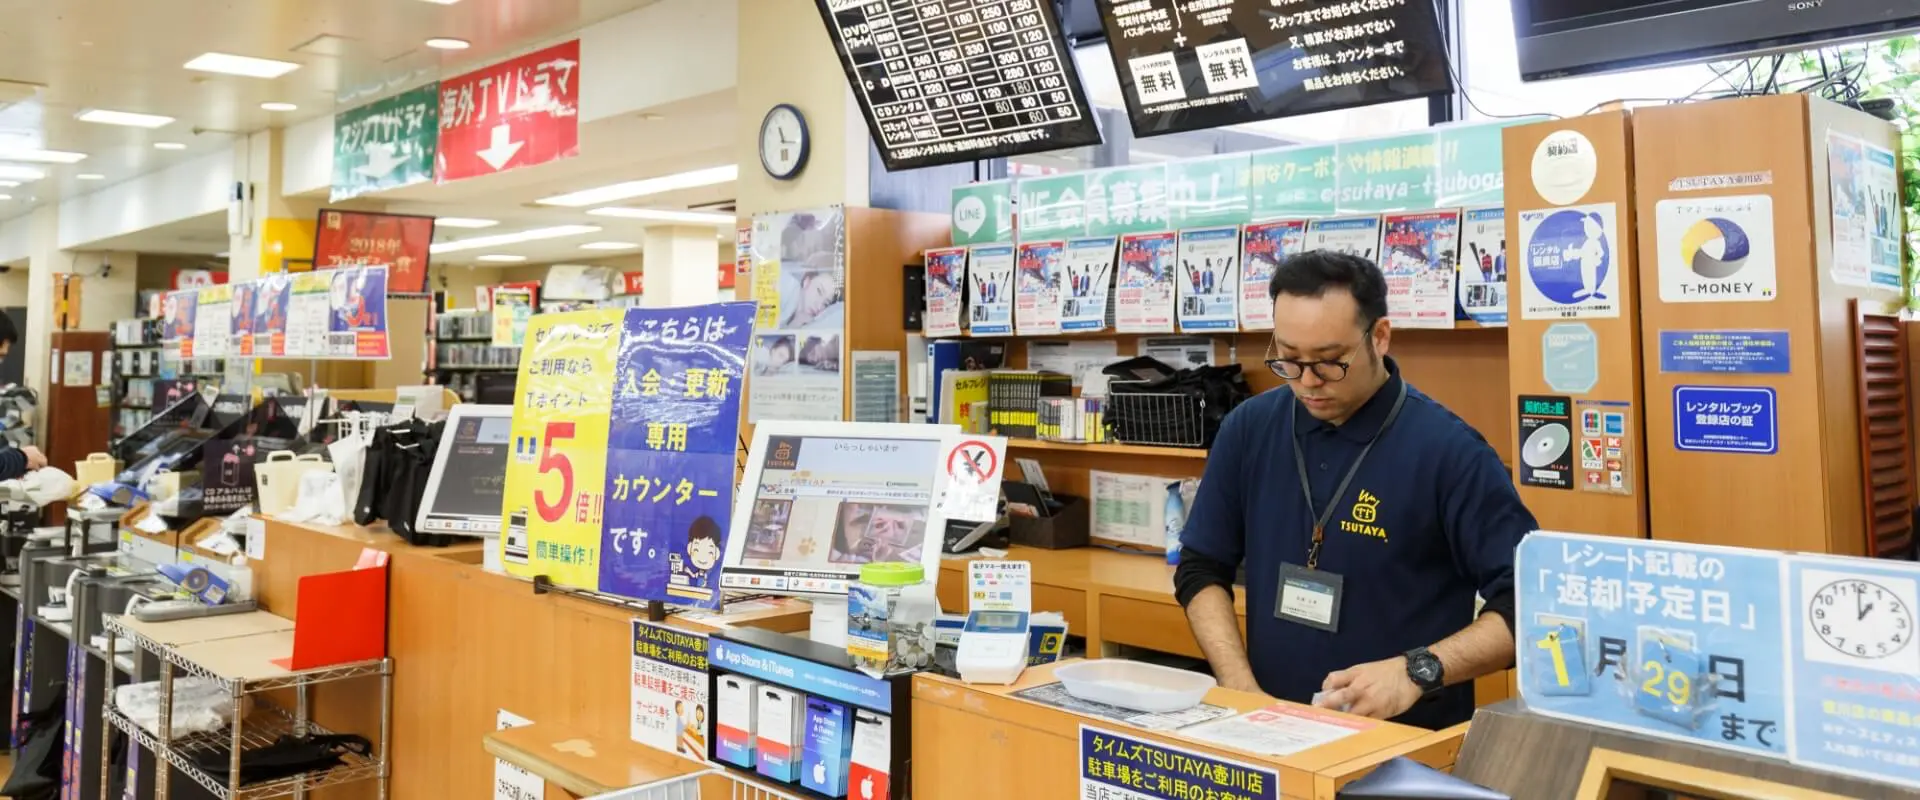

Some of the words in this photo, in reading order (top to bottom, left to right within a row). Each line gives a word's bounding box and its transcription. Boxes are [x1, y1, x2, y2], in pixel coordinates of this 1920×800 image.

[921, 5, 940, 17] 300
[981, 6, 1001, 19] 250
[1788, 0, 1823, 11] SONY
[843, 23, 869, 37] DVD
[987, 21, 1007, 34] 100
[1016, 14, 1037, 28] 100
[1022, 30, 1043, 43] 120
[998, 52, 1019, 64] 300
[1028, 45, 1048, 58] 120
[924, 83, 942, 95] 220
[1034, 61, 1054, 73] 120
[441, 58, 577, 129] 海外TVドラマ
[956, 92, 975, 104] 100
[983, 87, 1002, 99] 120
[1011, 80, 1031, 94] 180
[1040, 76, 1060, 88] 100
[959, 208, 981, 222] LINE
[1680, 282, 1753, 295] T-MONEY
[643, 315, 727, 342] こちらは
[529, 357, 593, 376] ご利用なら
[622, 368, 730, 399] 入会・更新
[526, 391, 587, 409] Tポイント
[1686, 401, 1762, 414] レンタルブック
[1696, 414, 1753, 427] 登録店の証
[647, 423, 688, 451] 専用
[612, 474, 718, 506] カウンター
[1340, 520, 1386, 539] TSUTAYA
[609, 527, 656, 559] です。
[1561, 541, 1725, 581] レシート記載の
[1832, 584, 1846, 597] 11
[1850, 583, 1868, 594] 12
[1875, 589, 1882, 600] 1
[1538, 569, 1756, 630] 「返却予定日」
[1816, 594, 1834, 606] 10
[1815, 608, 1825, 619] 9
[1889, 601, 1900, 613] 2
[1821, 624, 1831, 636] 8
[1896, 617, 1906, 629] 3
[1834, 636, 1846, 648] 7
[1891, 633, 1901, 643] 4
[1856, 644, 1867, 656] 6
[1876, 642, 1887, 654] 5
[726, 650, 741, 665] App
[742, 653, 760, 669] Store
[761, 661, 768, 672] &
[769, 662, 794, 678] iTunes
[1536, 632, 1570, 687] 1
[1596, 636, 1628, 681] 月
[1641, 660, 1691, 706] 29
[1708, 654, 1746, 702] 日
[1720, 713, 1777, 747] まで
[1092, 734, 1263, 795] タイムズTSUTAYA壺川店
